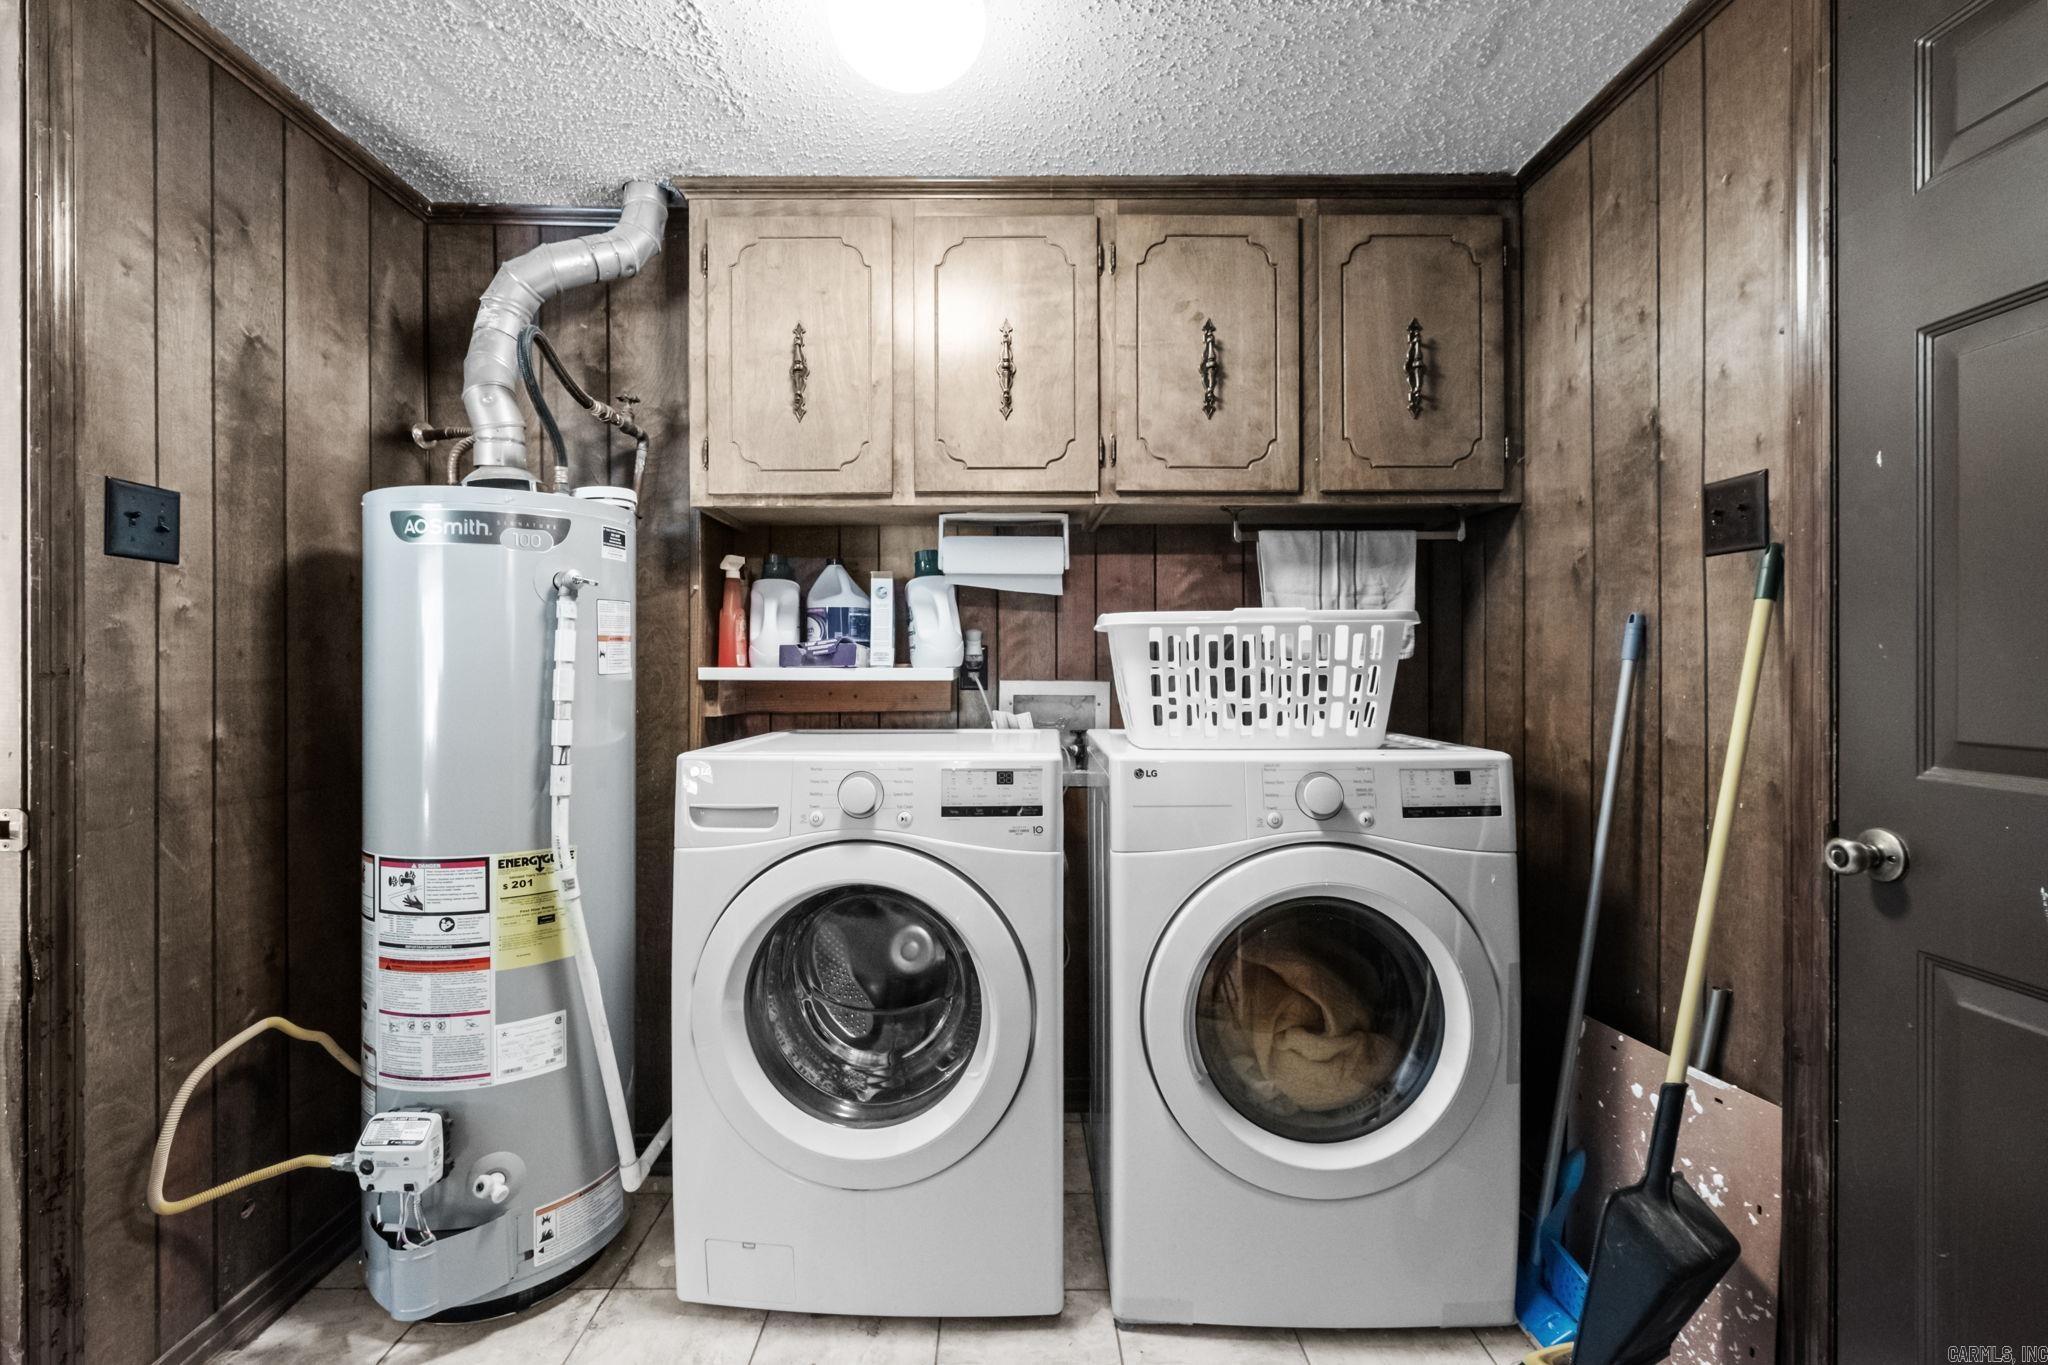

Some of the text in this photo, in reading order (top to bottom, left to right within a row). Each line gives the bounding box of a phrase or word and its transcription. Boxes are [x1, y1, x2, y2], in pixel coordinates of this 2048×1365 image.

[512, 532, 541, 547] 100
[1146, 769, 1158, 778] LG
[511, 878, 534, 889] 201
